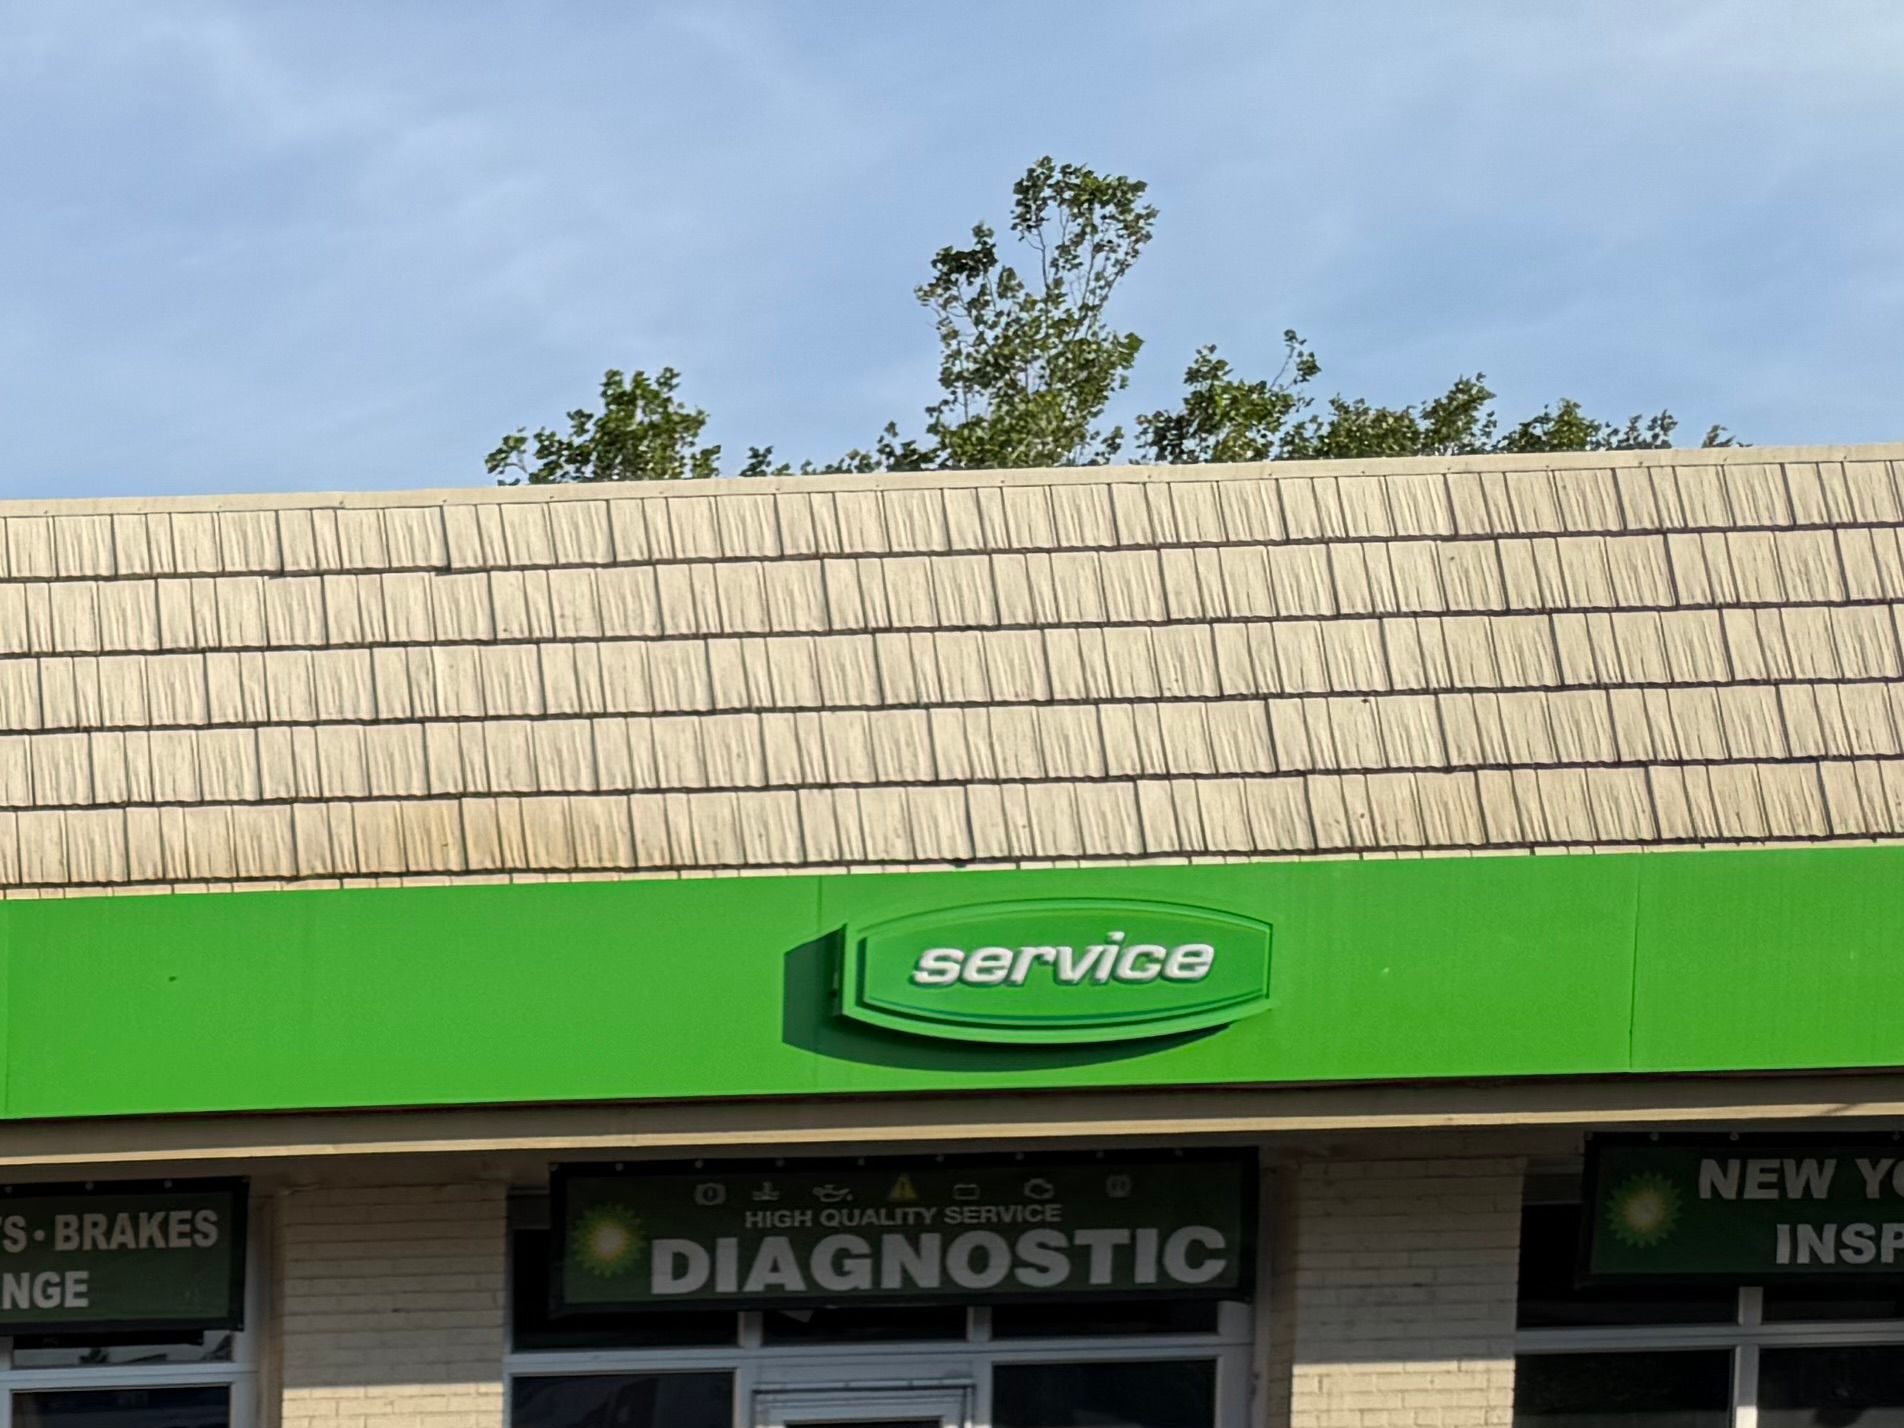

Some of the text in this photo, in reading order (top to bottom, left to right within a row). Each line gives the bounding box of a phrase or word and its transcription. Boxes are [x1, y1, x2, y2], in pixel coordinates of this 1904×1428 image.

[912, 931, 1215, 986] service
[1698, 1158, 1837, 1199] NEW
[54, 1209, 219, 1252] BRAKES
[745, 1203, 1062, 1228] HIGH QUALITY SERVICE
[650, 1225, 1228, 1295] DIAGNOSTIC
